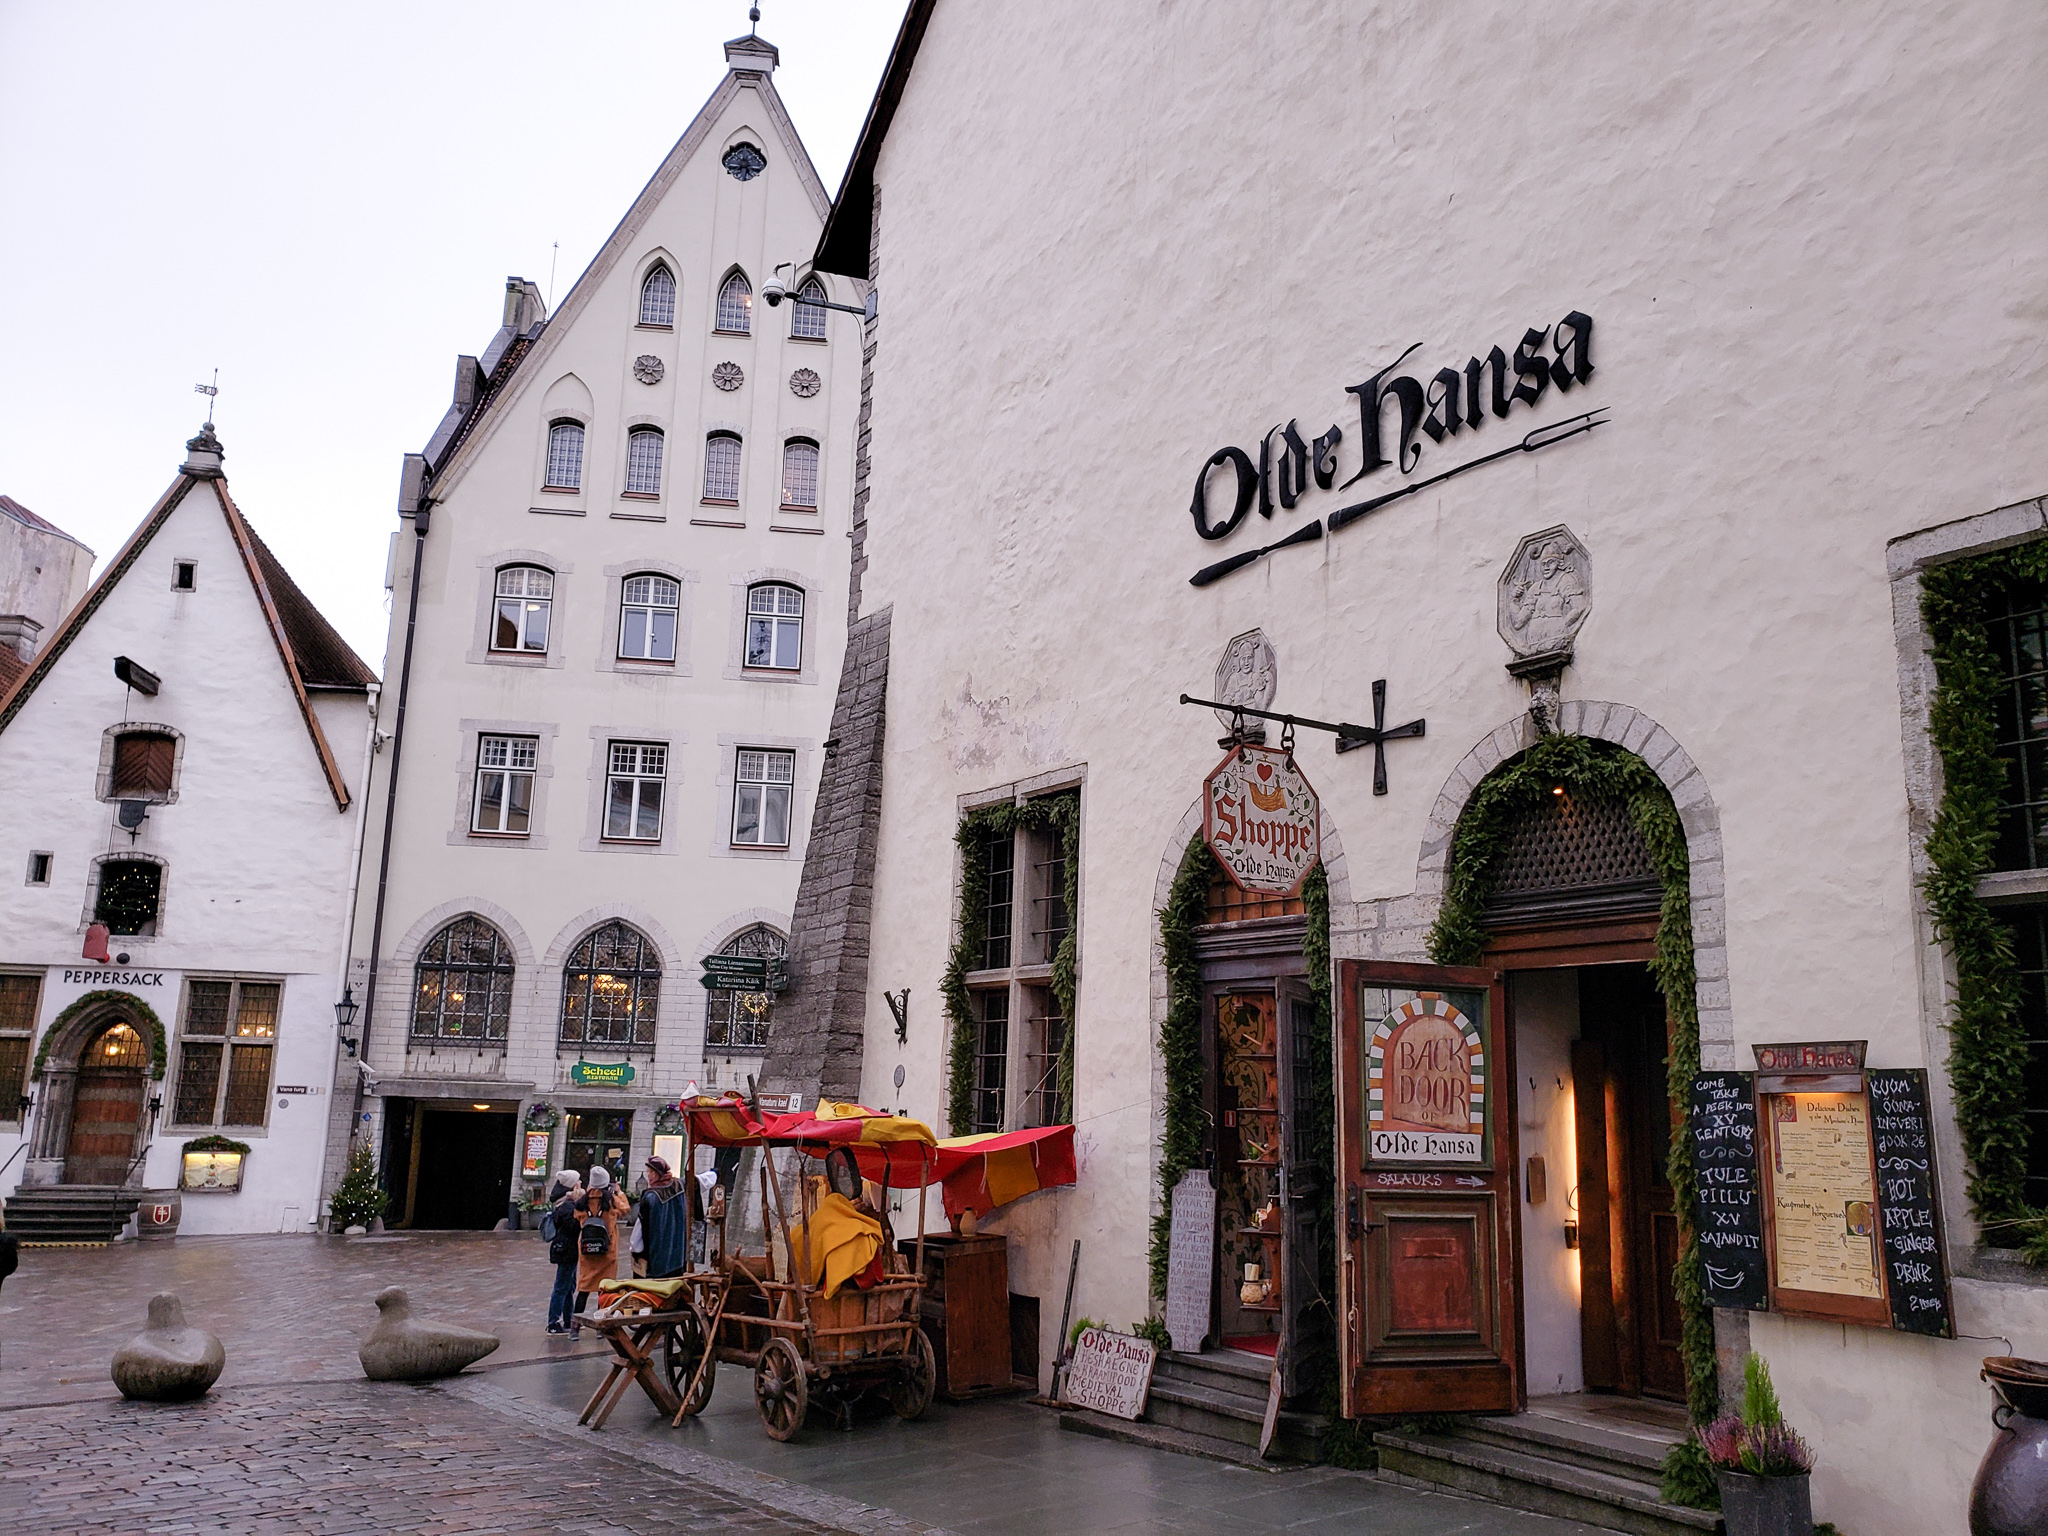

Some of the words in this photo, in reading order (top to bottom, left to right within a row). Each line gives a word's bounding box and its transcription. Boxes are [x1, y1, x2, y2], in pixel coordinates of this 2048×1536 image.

[1189, 417, 1342, 541] Olde
[1213, 792, 1314, 862] Shoppe
[1233, 853, 1262, 875] Olde
[63, 970, 164, 986] PEPPERSACK
[717, 975, 744, 984] Katariina
[1400, 1037, 1469, 1075] BACK
[1696, 1078, 1725, 1091] COME
[1870, 1078, 1911, 1099] KUUM
[792, 1098, 799, 1108] 12
[1400, 1075, 1468, 1120] DOOR
[1710, 1088, 1739, 1100] TAKE
[1693, 1104, 1700, 1116] A
[1705, 1100, 1734, 1115] PEEK
[1713, 1113, 1738, 1127] XV
[1876, 1116, 1924, 1131] INGVERI
[1695, 1124, 1754, 1141] CENTURY
[1374, 1132, 1419, 1154] Olde
[1879, 1134, 1908, 1153] JOOK
[1911, 1134, 1926, 1148] 2€
[1377, 1173, 1443, 1186] SALAUKS
[1701, 1167, 1749, 1185] TULE
[1887, 1177, 1917, 1202] HOT
[1776, 1197, 1811, 1211] Kaupmehe
[1176, 1208, 1210, 1219] KINGID
[1711, 1211, 1740, 1226] XV
[1884, 1206, 1933, 1230] APPLE
[1699, 1230, 1759, 1249] SAJANDIT
[1909, 1295, 1919, 1312] 2
[1081, 1331, 1112, 1354] Olde
[1071, 1374, 1123, 1398] MEDIEVAL
[1080, 1389, 1126, 1413] SHOPPE
